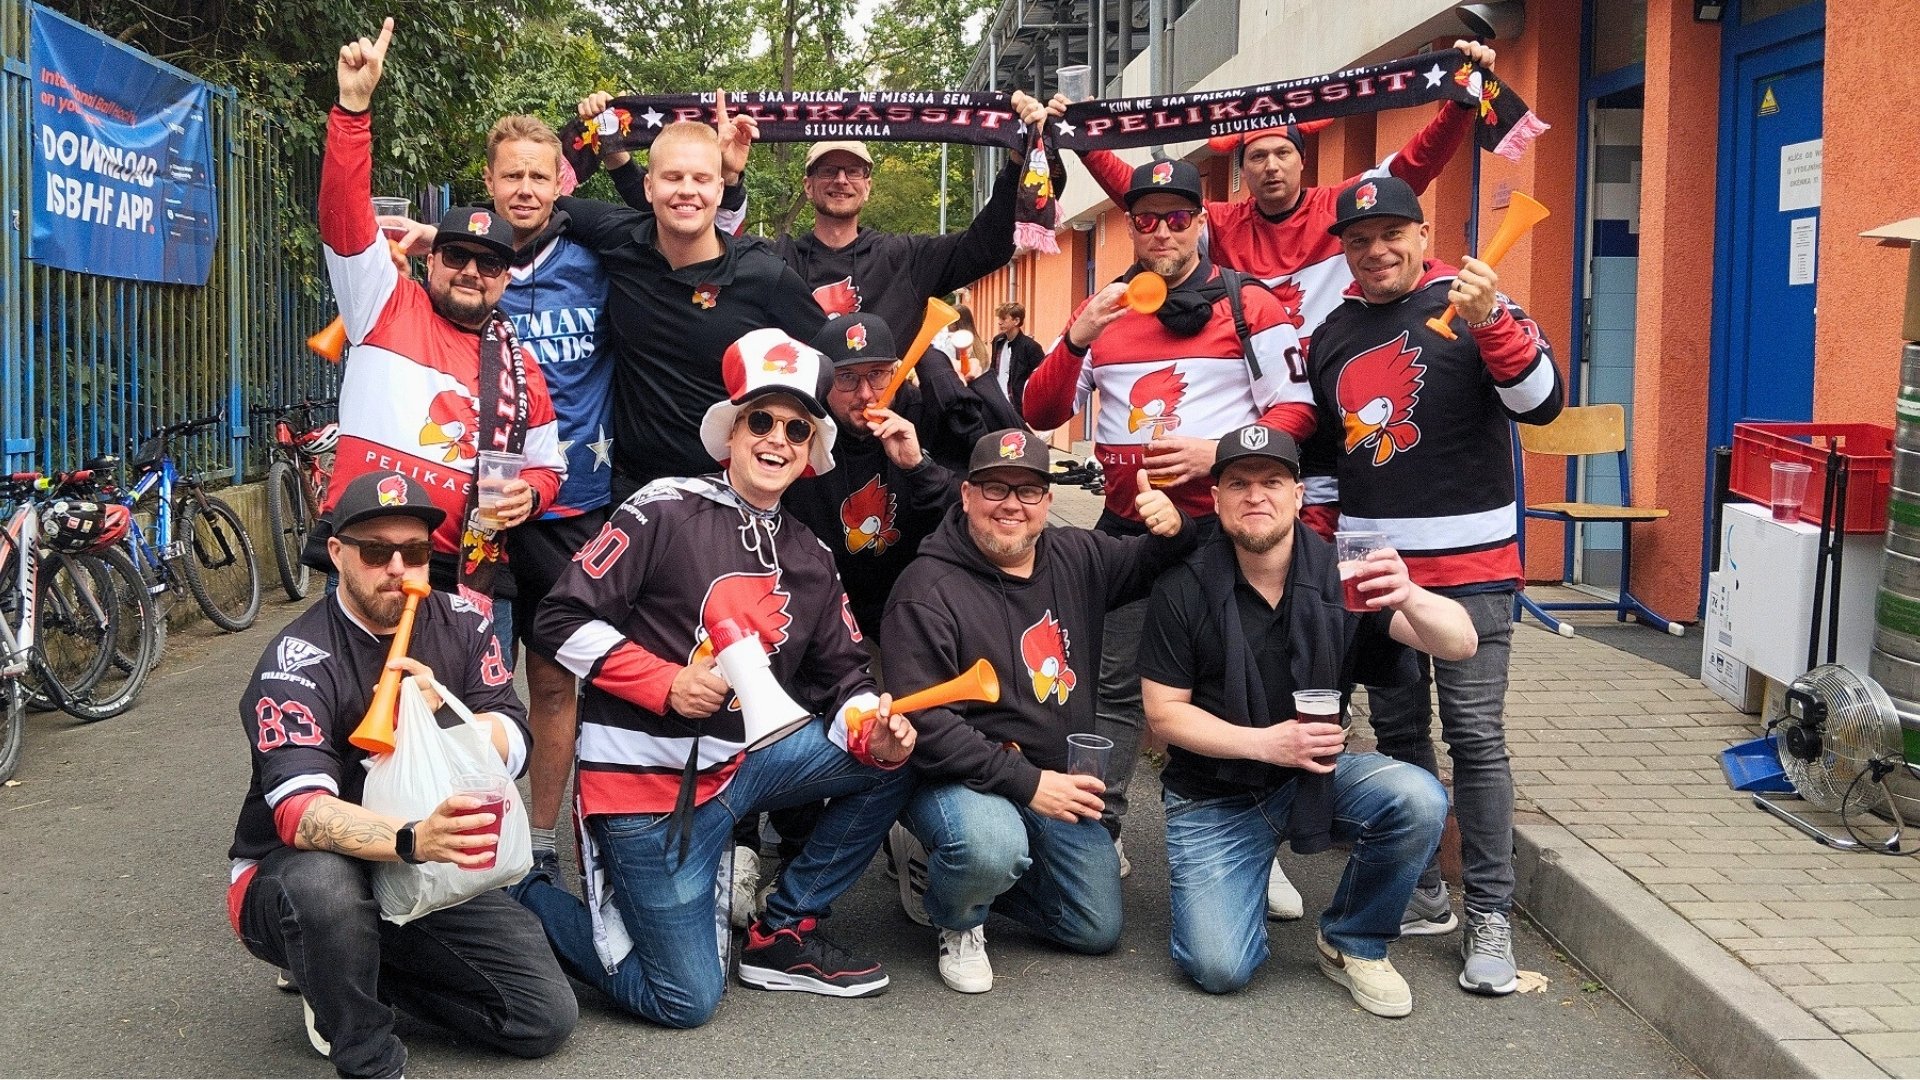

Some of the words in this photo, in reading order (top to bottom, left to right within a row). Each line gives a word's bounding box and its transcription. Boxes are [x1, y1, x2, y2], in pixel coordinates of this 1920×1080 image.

[41, 91, 56, 107] on
[732, 91, 749, 102] NE
[759, 91, 785, 102] SAA
[860, 91, 877, 102] NE
[881, 92, 935, 104] MISSAA
[1085, 69, 1416, 137] PELIKASSIT
[1137, 98, 1152, 109] NE
[1162, 96, 1186, 106] SAA
[671, 103, 1013, 129] PELIKASSIT
[42, 125, 157, 188] DOWNLOAD
[46, 171, 115, 227] ISBHF
[116, 191, 155, 235] APP.
[510, 307, 597, 340] YMAN
[522, 334, 596, 364] ANDS
[366, 451, 471, 495] PELIKAS
[1103, 452, 1145, 465] PELI
[255, 696, 325, 753] 83
